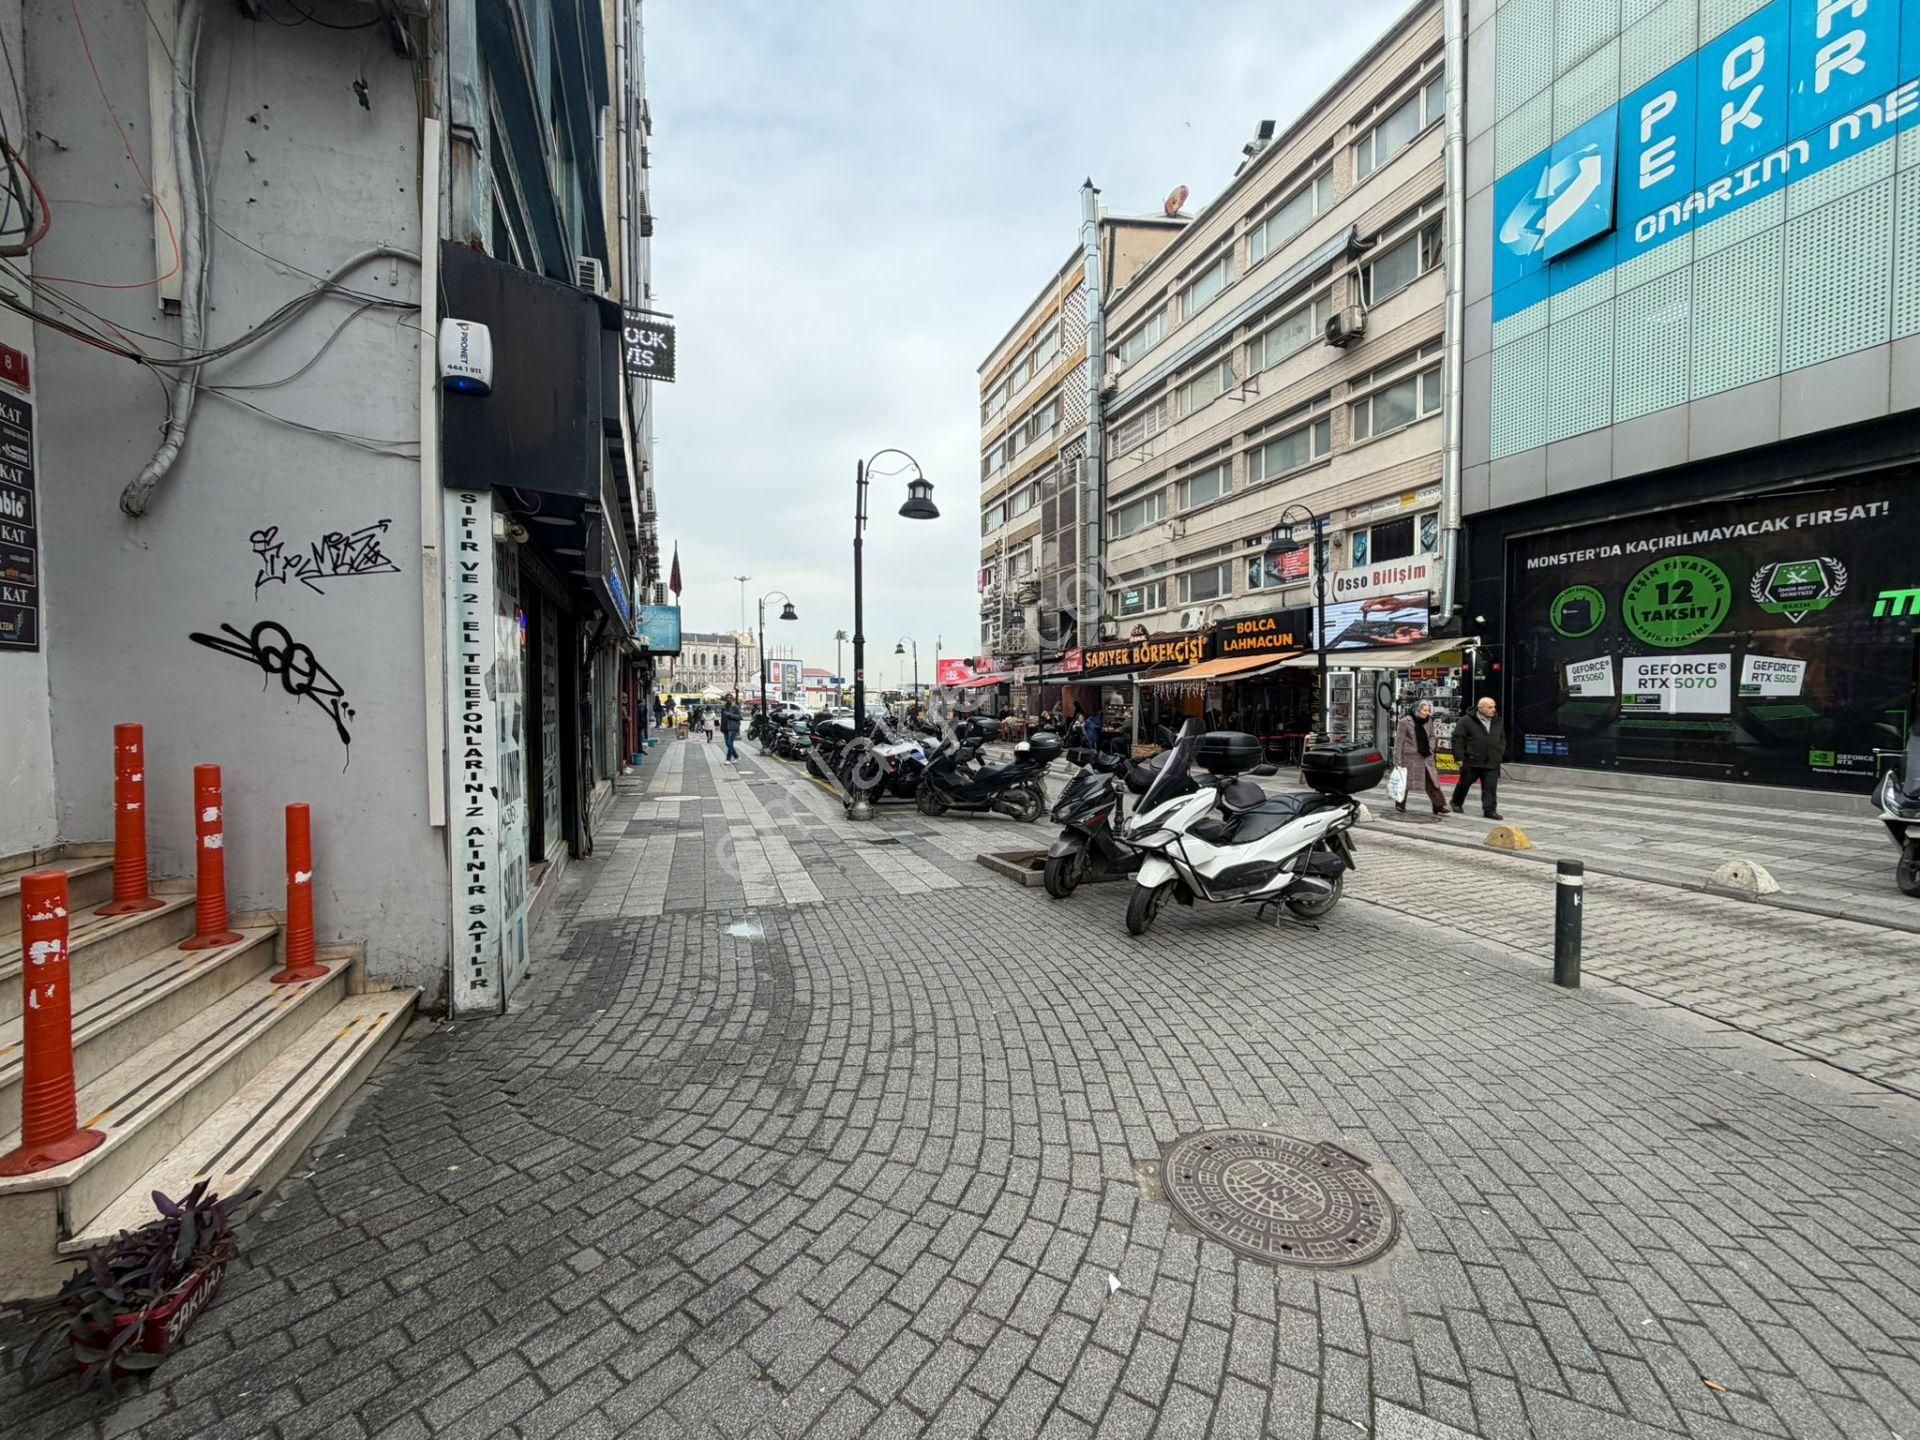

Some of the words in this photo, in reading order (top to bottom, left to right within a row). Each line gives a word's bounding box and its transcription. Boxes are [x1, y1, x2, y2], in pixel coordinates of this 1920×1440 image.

[460, 331, 469, 365] PRONET
[460, 493, 480, 552] SIFIR
[2, 525, 26, 544] KAT
[1527, 544, 1622, 569] MONSTER'DA
[1626, 516, 1791, 554] KAÇIRILMAYACAK
[1795, 501, 1891, 528] FIRSAT!
[460, 561, 480, 584] VE
[3, 586, 28, 603] KAT
[1655, 579, 1694, 606] 12
[1641, 604, 1709, 622] TAKSİT
[1236, 617, 1276, 634] BOLCA
[1224, 634, 1293, 651] LAHMACUN
[1085, 646, 1131, 669] SARIYER
[1638, 678, 1670, 689] RTX
[1674, 677, 1718, 689] 5070
[1751, 673, 1773, 682] RTX
[462, 653, 485, 817] TELEFONLARINIZ
[1836, 753, 1874, 762] GEFORCE
[465, 826, 486, 895] ALINIR
[467, 905, 488, 990] SATILIR
